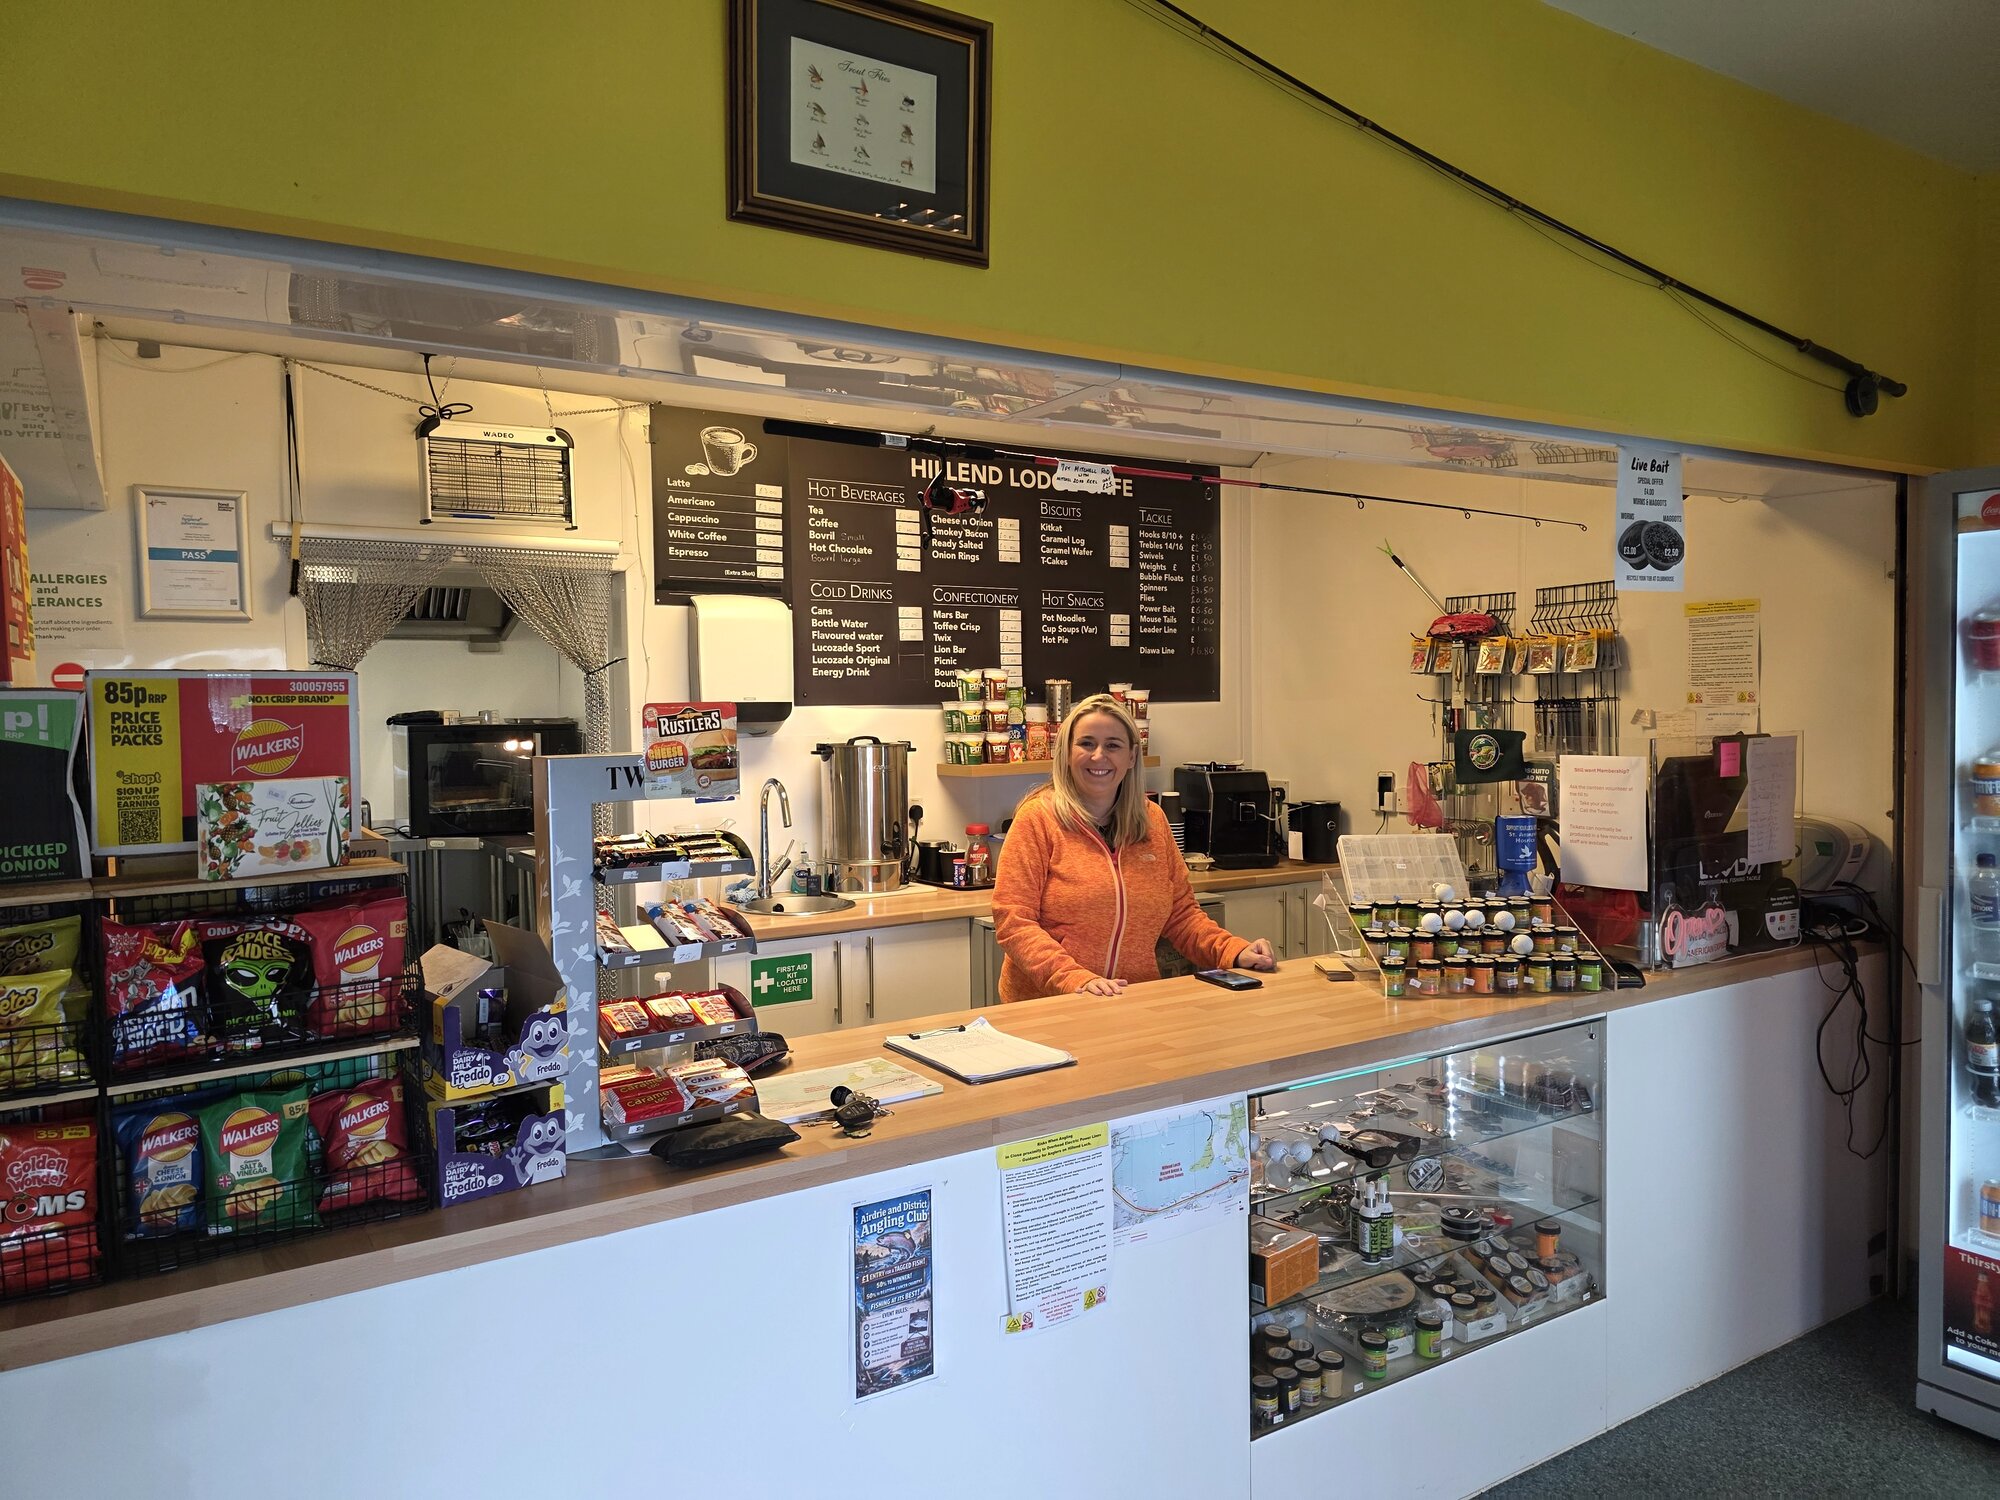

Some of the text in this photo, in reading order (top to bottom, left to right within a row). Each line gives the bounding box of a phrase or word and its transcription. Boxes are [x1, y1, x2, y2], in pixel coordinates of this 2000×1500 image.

[838, 60, 891, 83] Trout Flies
[1631, 458, 1669, 473] Live Bait
[667, 478, 690, 488] Latte
[841, 484, 905, 504] BEVERAGES
[668, 495, 715, 507] Americano
[808, 506, 823, 515] Tea
[1040, 501, 1082, 518] BISCUITS
[668, 513, 720, 525] Cappuccino
[931, 515, 993, 528] Cheese Onion
[1139, 509, 1172, 524] TACKLE
[808, 518, 838, 528] Coffee
[1040, 523, 1062, 532] Kitkat
[669, 530, 727, 542] White Coffee
[809, 531, 835, 541] Bovril
[931, 527, 989, 539] Smokey Bacon
[1139, 530, 1176, 539] Hooks 8/10
[932, 539, 983, 551] Ready Salted
[1040, 535, 1085, 547] Caramel Log
[1139, 541, 1163, 549] Trebles
[669, 547, 709, 559] Espresso
[809, 543, 873, 555] Hot Chocolate
[1040, 546, 1093, 556] Caramel Wafer
[182, 551, 207, 559] PASS
[932, 551, 979, 563] Onion Rings
[1139, 551, 1164, 559] Swivels
[1041, 557, 1068, 566] T-Cakes
[1139, 562, 1166, 571] Weights
[30, 573, 108, 585] ALLERGIES
[1140, 573, 1184, 582] Bubble Floats
[36, 586, 58, 594] and
[1140, 584, 1167, 592] Spinners
[32, 597, 103, 608] LERANCES
[933, 588, 1019, 606] CONFECTIONERY
[1140, 594, 1155, 602] Flies
[811, 606, 833, 615] Cans
[1163, 605, 1175, 613] Bait
[933, 610, 968, 620] Mars Bar
[1042, 614, 1086, 623] Pot Noodles
[1140, 615, 1161, 623] Mouse
[811, 619, 868, 629] Bottle Water
[933, 622, 980, 633] Toffee Crisp
[1042, 625, 1098, 635] Cup Soups (Var)
[1164, 626, 1177, 634] Line
[812, 631, 883, 642] Flavoured water
[934, 634, 952, 642] Twix
[1042, 636, 1069, 644] Hot Pie
[812, 643, 880, 654] Lucozade Sport
[934, 645, 966, 654] Lion Bar
[812, 656, 891, 667] Lucozade Original
[934, 656, 957, 665] Picnic
[812, 668, 870, 678] Energy Drink
[289, 682, 345, 692] 300057955
[104, 682, 167, 708] 85p RRP
[110, 711, 160, 724] PRICE
[660, 711, 721, 735] RUSTLERS
[111, 724, 162, 734] MARKED
[111, 734, 163, 746] PACKS
[236, 734, 300, 761] WALKERS
[648, 746, 683, 759] CHEESE
[650, 757, 685, 770] BURGER
[117, 787, 142, 795] SIGN
[117, 800, 159, 808] EARNING
[251, 807, 288, 827] Fruit
[1, 858, 59, 871] ONION
[207, 926, 240, 937] ONLY
[235, 930, 282, 946] SPACE
[220, 943, 296, 963] RAIDERS
[334, 936, 384, 966] WALKERS
[776, 965, 796, 973] FIRST
[777, 978, 807, 987] LOCATED
[783, 985, 801, 993] HERE
[453, 1054, 477, 1065] DAIRY
[453, 1063, 471, 1071] MILK
[452, 1063, 561, 1086] Freddo Freddo
[339, 1100, 390, 1130] WALKERS
[142, 1124, 199, 1153] WALKERS
[222, 1118, 279, 1148] WALKERS
[7, 1154, 67, 1178] Golden
[240, 1162, 257, 1170] SALT
[446, 1164, 470, 1175] DAIRY
[156, 1167, 187, 1177] CHEESE
[445, 1158, 559, 1197] Freddo Freddo
[446, 1173, 464, 1182] MILK
[6, 1171, 68, 1193] Wonder
[861, 1201, 927, 1223] Airdrie and District
[861, 1209, 928, 1238] Angling Club
[1947, 1326, 1998, 1349] Add a Coke
[1955, 1336, 1988, 1354] to your
